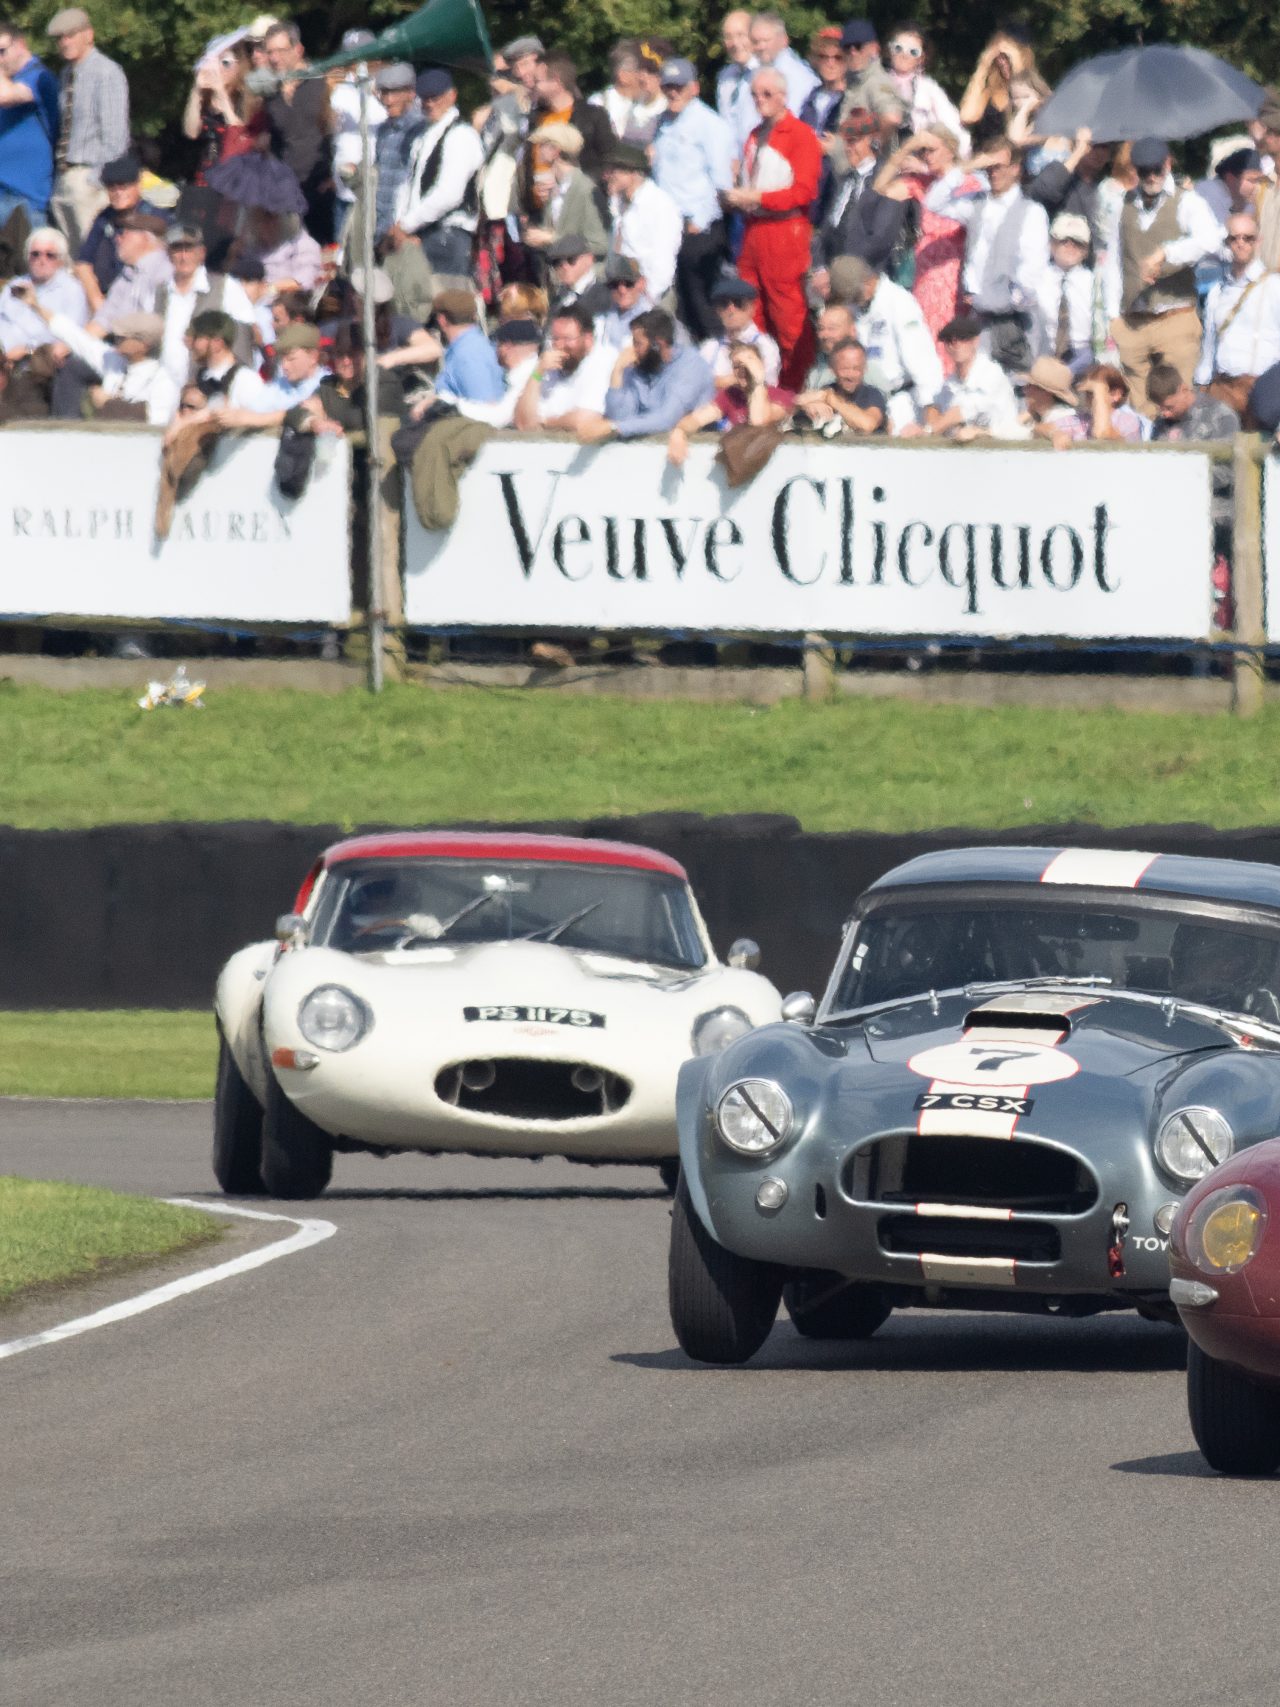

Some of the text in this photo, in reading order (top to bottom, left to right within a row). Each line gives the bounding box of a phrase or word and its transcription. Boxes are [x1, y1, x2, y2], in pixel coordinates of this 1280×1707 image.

[11, 506, 294, 541] RALPH AUREN
[492, 470, 1122, 614] Veuve Clicquot
[479, 1007, 592, 1026] PS 1175
[969, 1047, 1041, 1072] 7
[920, 1095, 1028, 1114] 7 CSX
